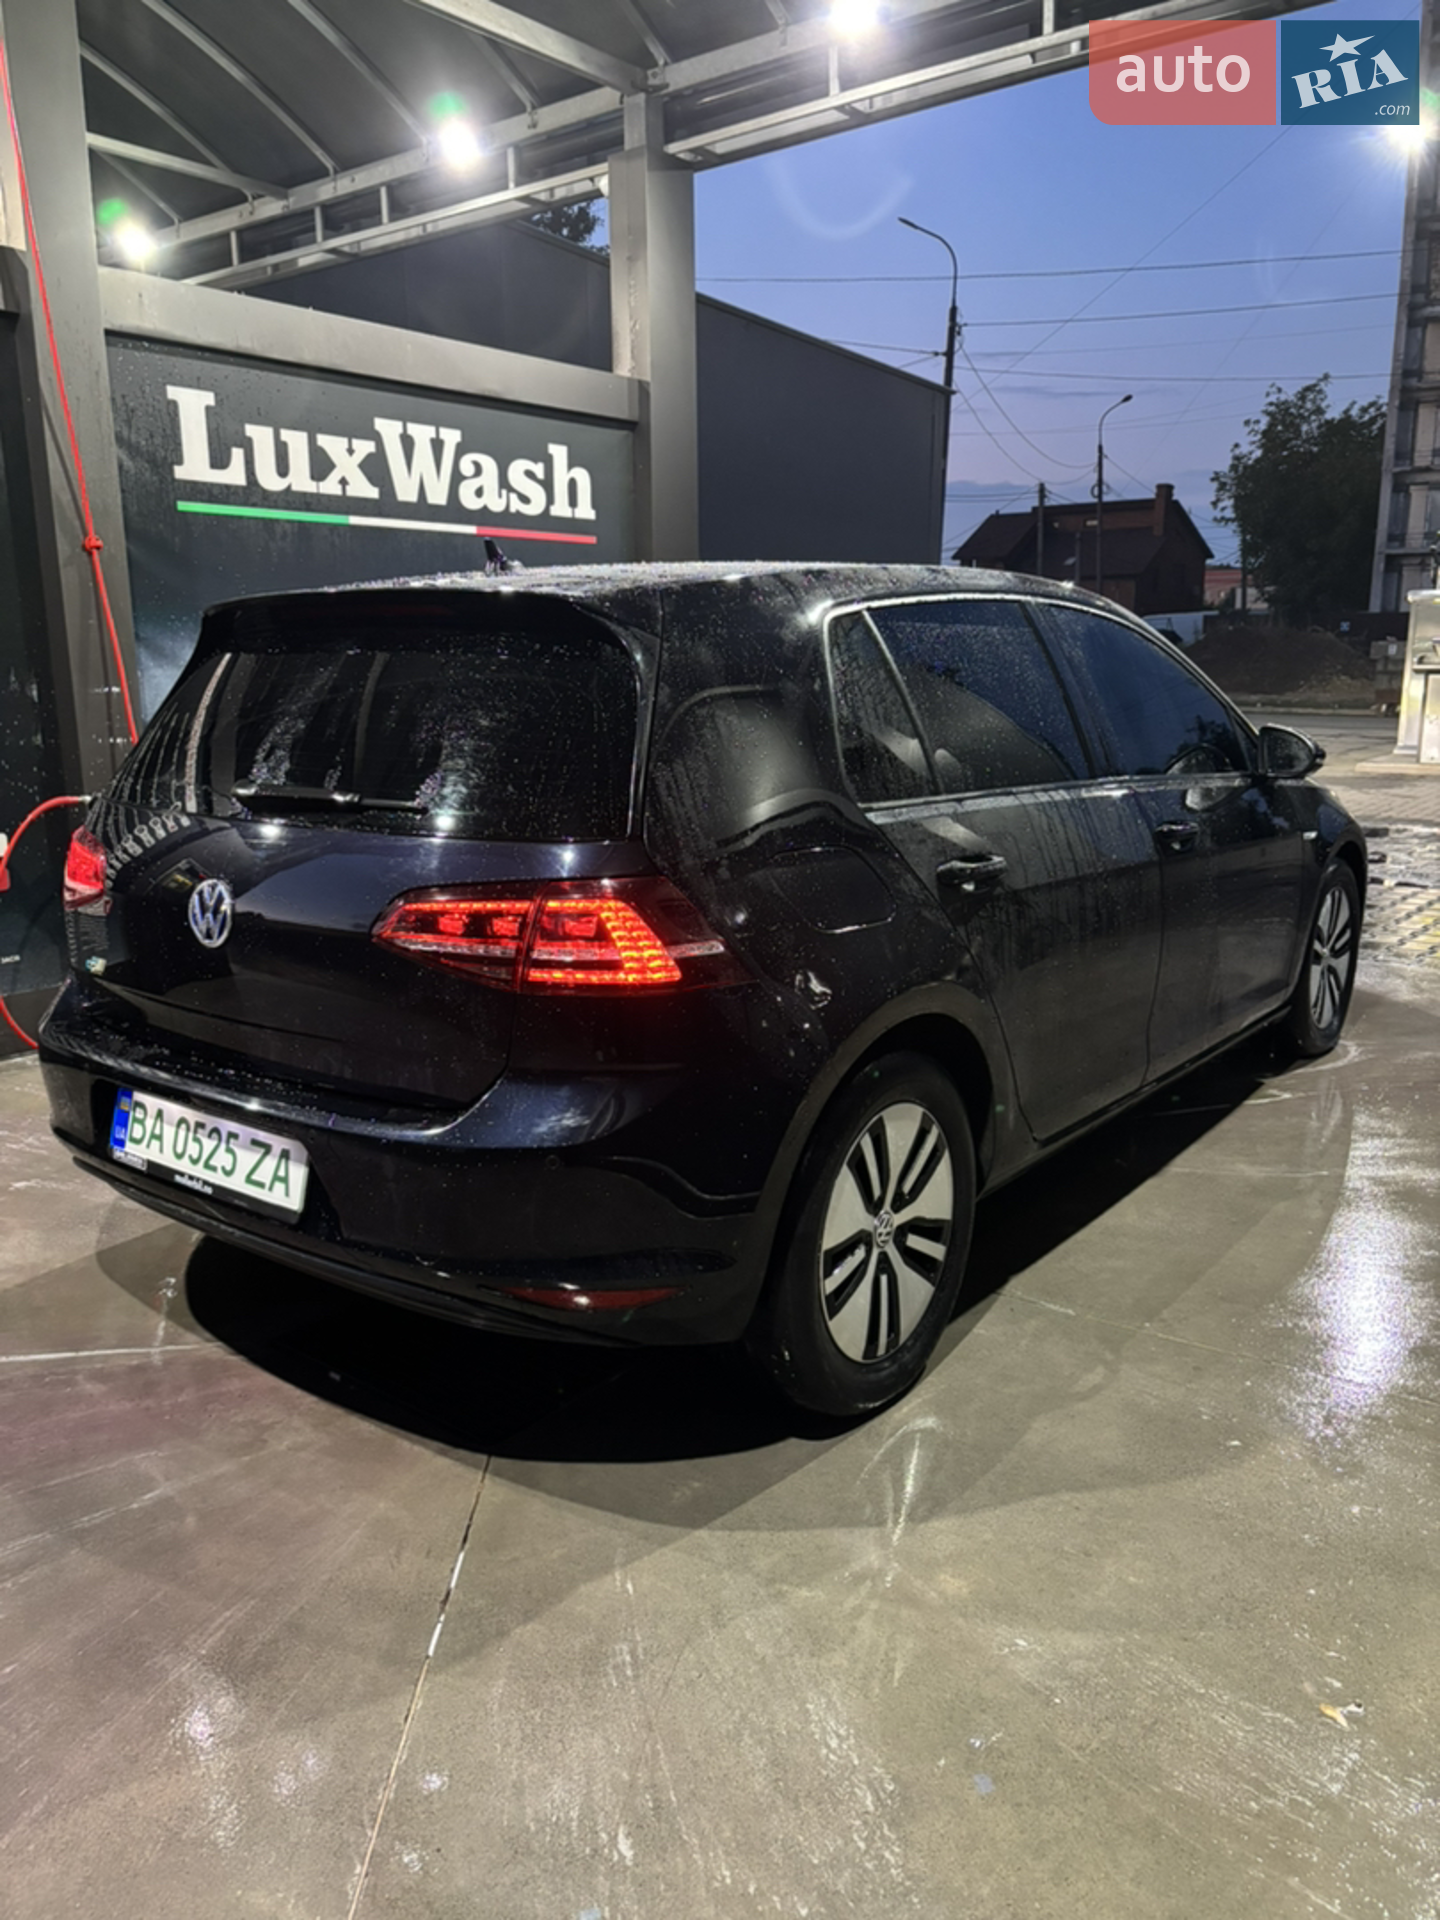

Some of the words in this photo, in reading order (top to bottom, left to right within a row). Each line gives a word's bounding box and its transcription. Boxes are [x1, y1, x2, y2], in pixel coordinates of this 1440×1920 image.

[166, 384, 597, 521] LuxWash
[189, 880, 232, 947] VW
[127, 1101, 164, 1154] BA
[172, 1116, 239, 1178] 0525
[245, 1138, 292, 1198] ZA
